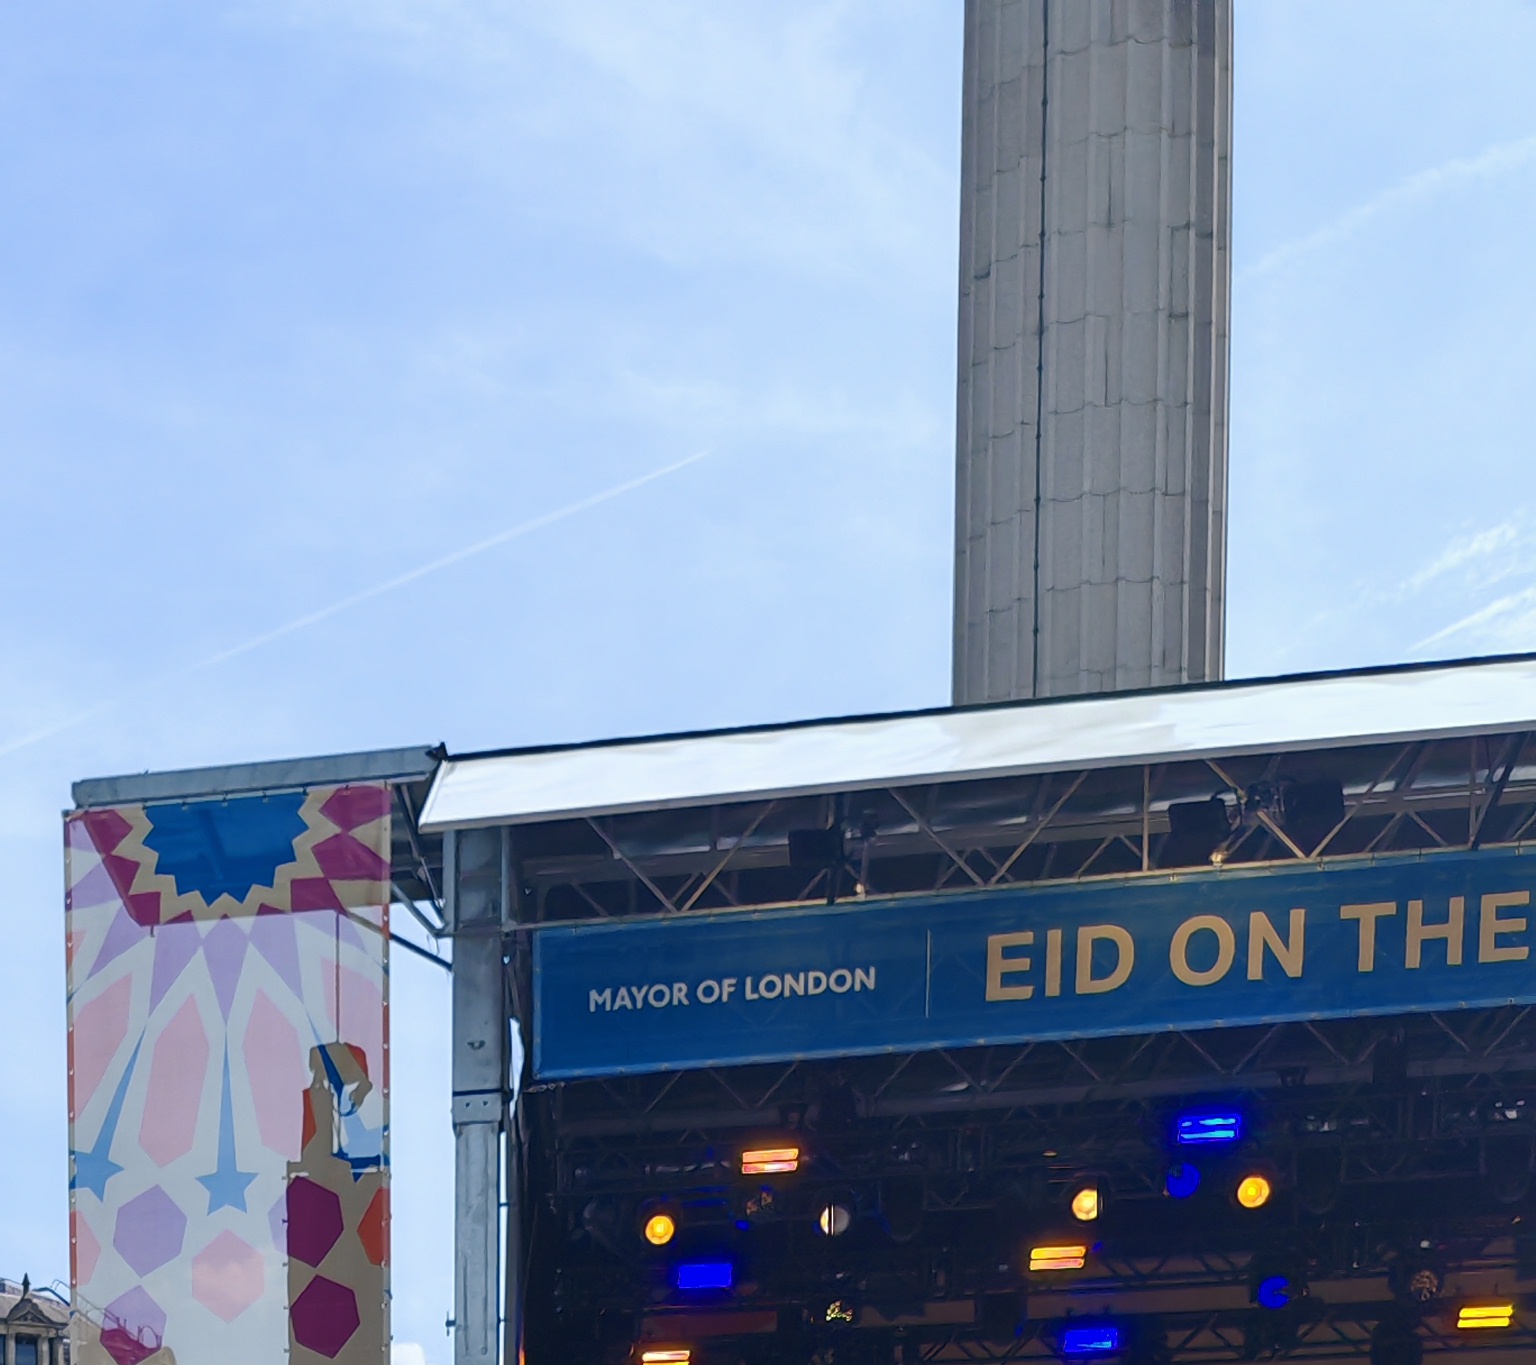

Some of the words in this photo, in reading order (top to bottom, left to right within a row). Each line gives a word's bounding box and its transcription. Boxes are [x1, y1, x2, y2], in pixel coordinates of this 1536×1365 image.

[984, 924, 1135, 1003] EID
[1169, 908, 1308, 984] ON
[1340, 890, 1531, 973] THE
[587, 982, 688, 1013] MAYOR
[696, 978, 737, 1004] OF
[744, 966, 877, 999] LONDON
